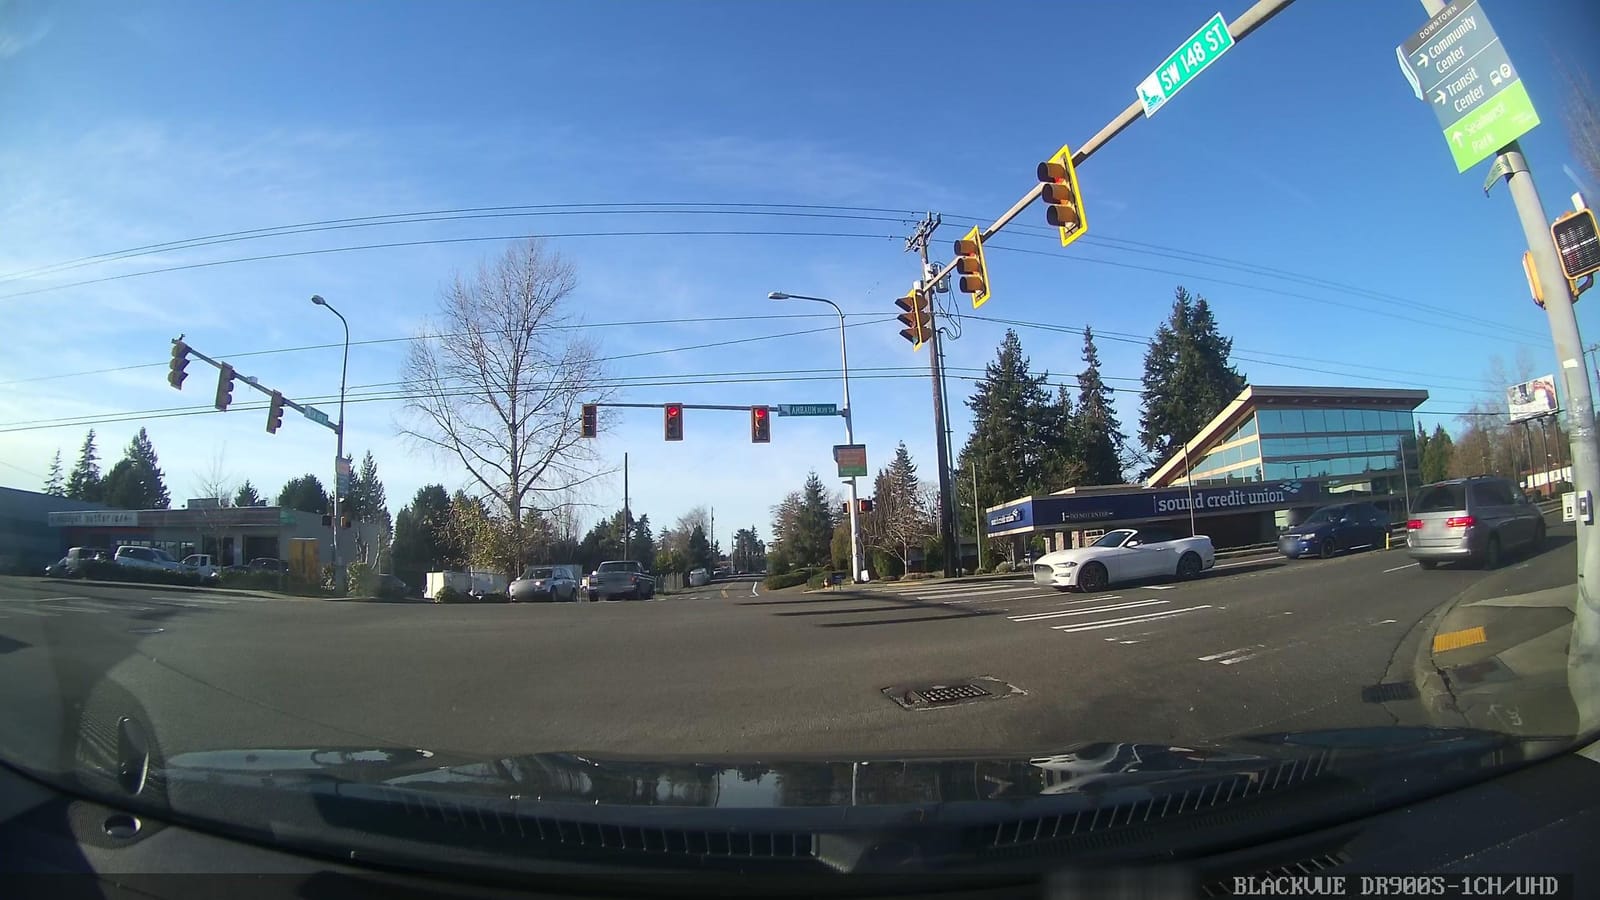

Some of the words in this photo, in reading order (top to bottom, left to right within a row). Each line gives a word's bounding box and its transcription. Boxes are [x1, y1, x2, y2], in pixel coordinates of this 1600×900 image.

[1419, 4, 1457, 39] DOWNTOWN
[1428, 15, 1477, 59] Community
[1161, 61, 1181, 91] SW
[1180, 41, 1206, 73] 148
[1205, 23, 1225, 51] ST
[1436, 46, 1465, 74] Center
[1446, 66, 1479, 97] Transit
[1454, 84, 1485, 113] Center
[1158, 493, 1204, 511] sound
[1207, 490, 1246, 508] credit
[1248, 488, 1285, 504] union
